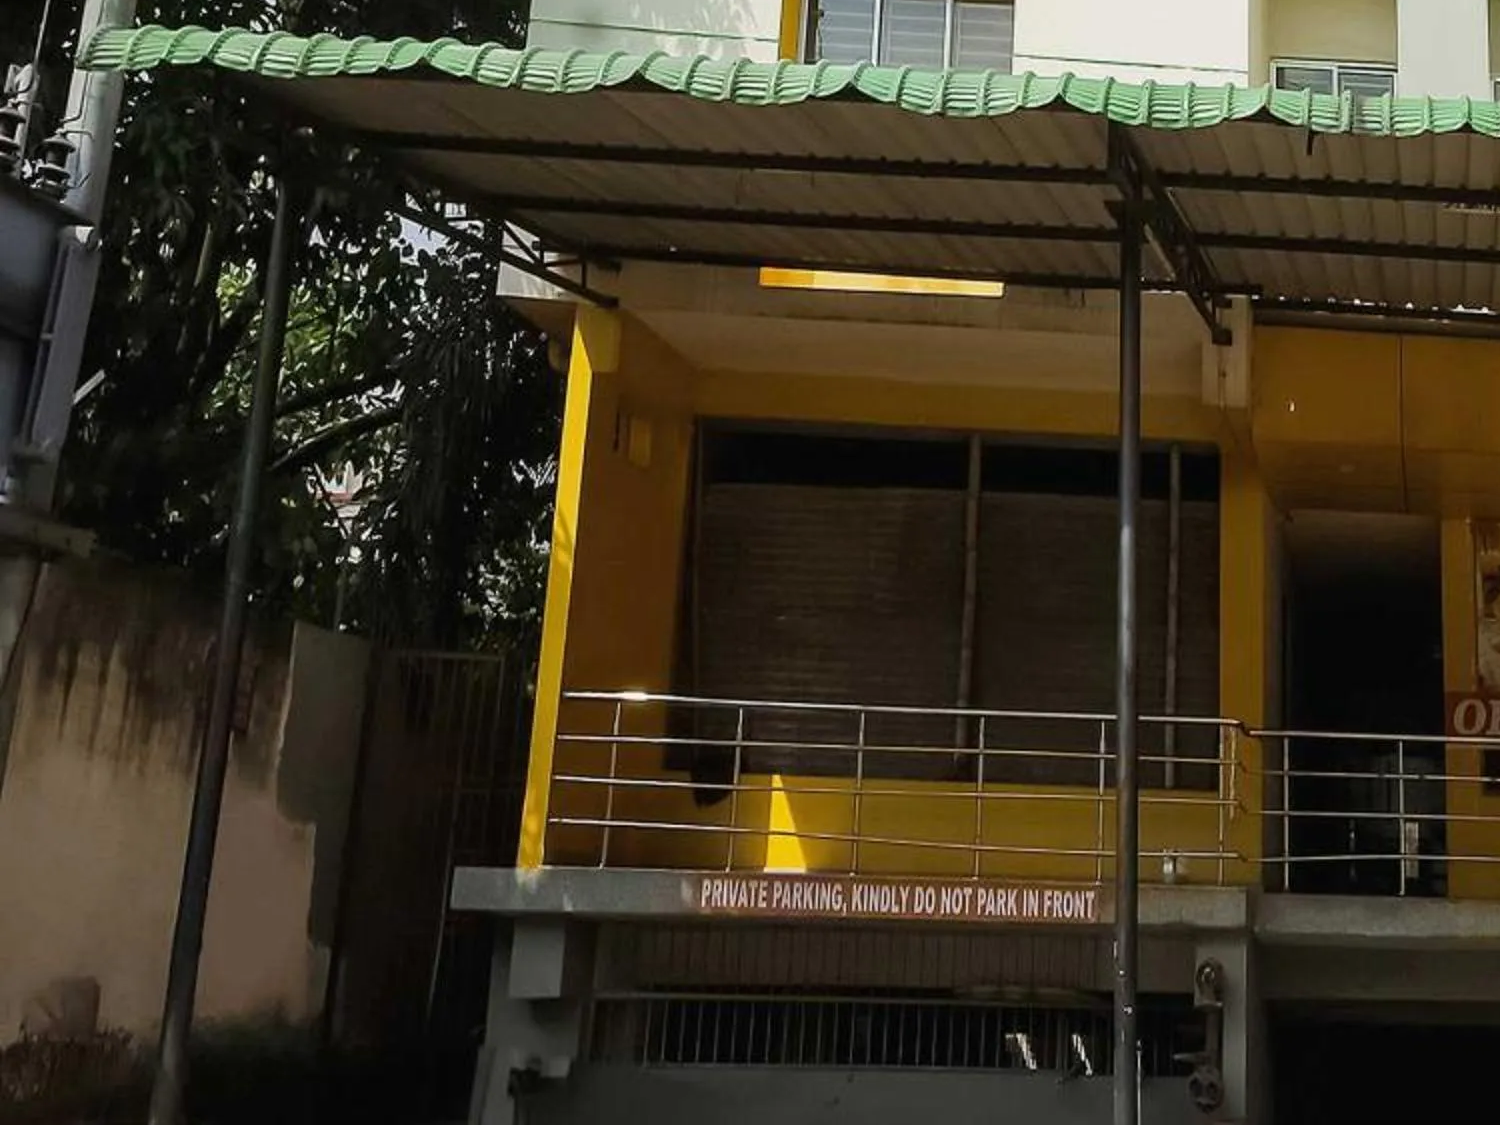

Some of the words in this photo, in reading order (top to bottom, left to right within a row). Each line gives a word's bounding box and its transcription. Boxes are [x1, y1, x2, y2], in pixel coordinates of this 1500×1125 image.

[701, 878, 768, 909] PRIVATE
[771, 880, 848, 916] PARKING,
[851, 883, 911, 914] KINDLY
[913, 884, 936, 914] DO
[940, 885, 974, 916] NOT
[976, 887, 1018, 917] PARK
[1022, 888, 1040, 917] IN
[1042, 889, 1096, 920] FRONT
